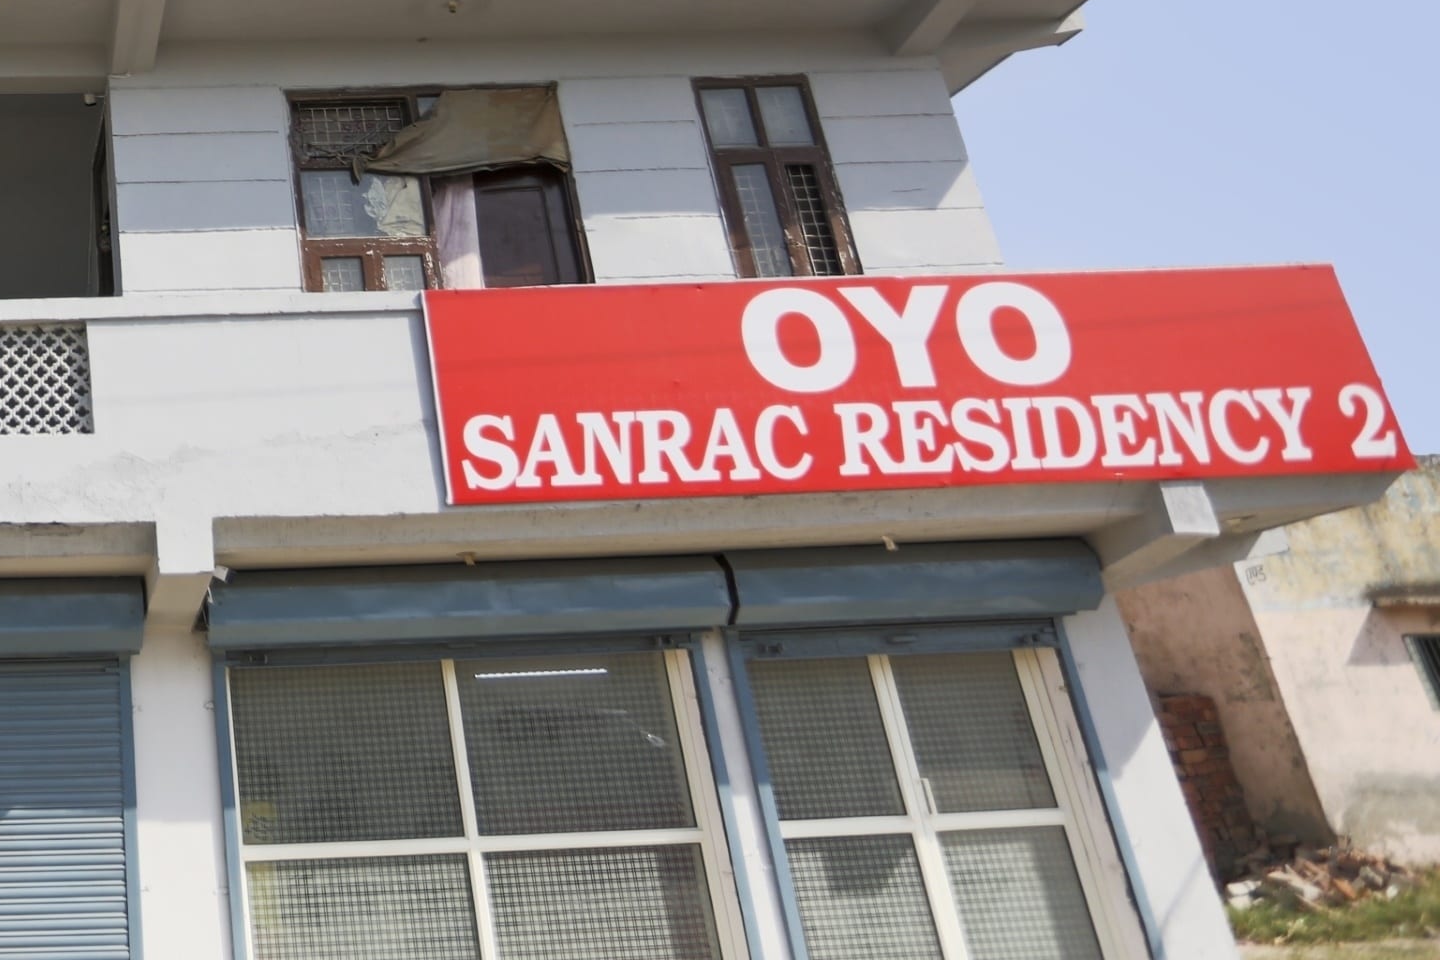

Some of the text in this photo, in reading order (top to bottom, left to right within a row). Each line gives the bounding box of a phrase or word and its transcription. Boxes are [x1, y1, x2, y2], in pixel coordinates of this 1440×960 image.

[741, 281, 1071, 393] OYO
[462, 385, 1396, 490] SANRAC RESIDENCY 2
